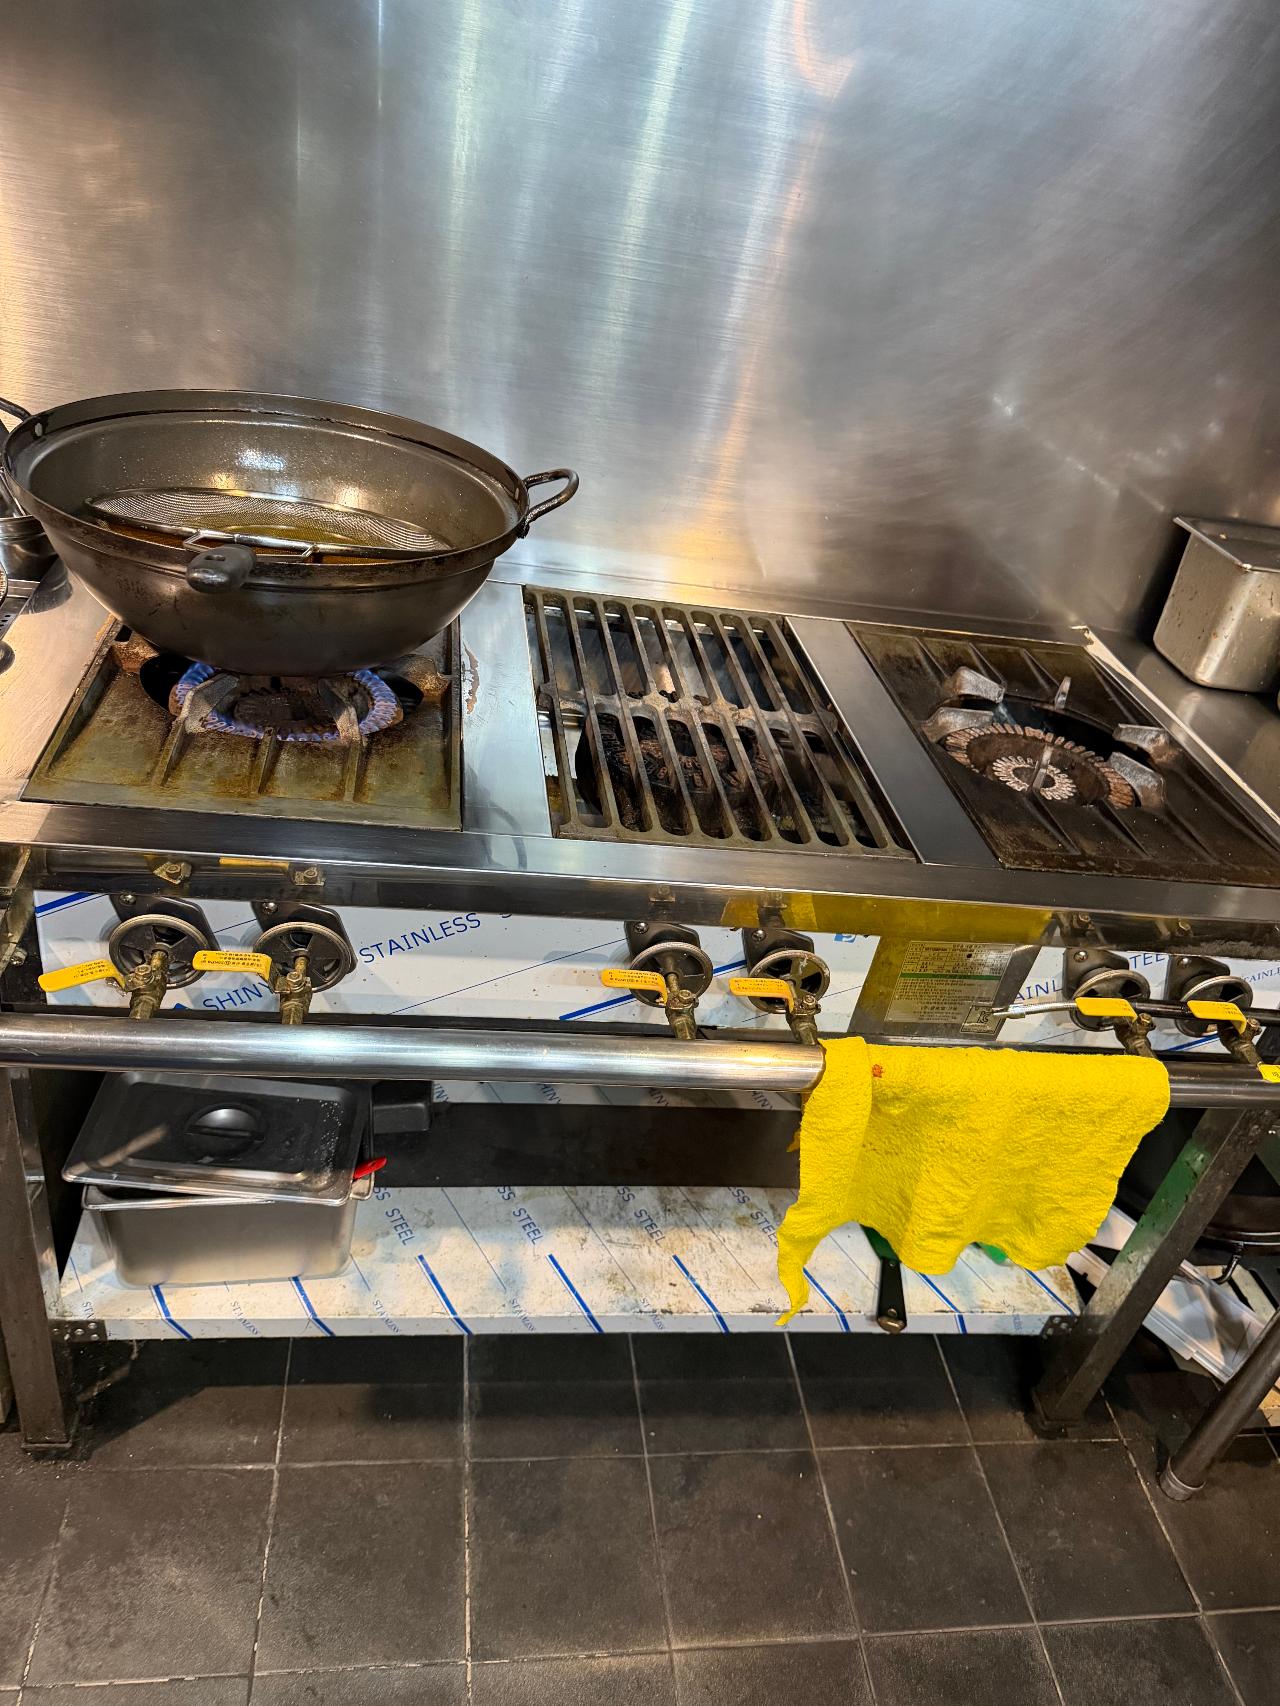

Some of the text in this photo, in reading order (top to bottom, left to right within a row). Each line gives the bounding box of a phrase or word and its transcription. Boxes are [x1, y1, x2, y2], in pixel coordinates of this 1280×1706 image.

[359, 912, 481, 963] STAINLESS
[385, 1207, 416, 1246] STEEL
[512, 1207, 544, 1245] STEEL
[633, 1208, 666, 1246] STEEL
